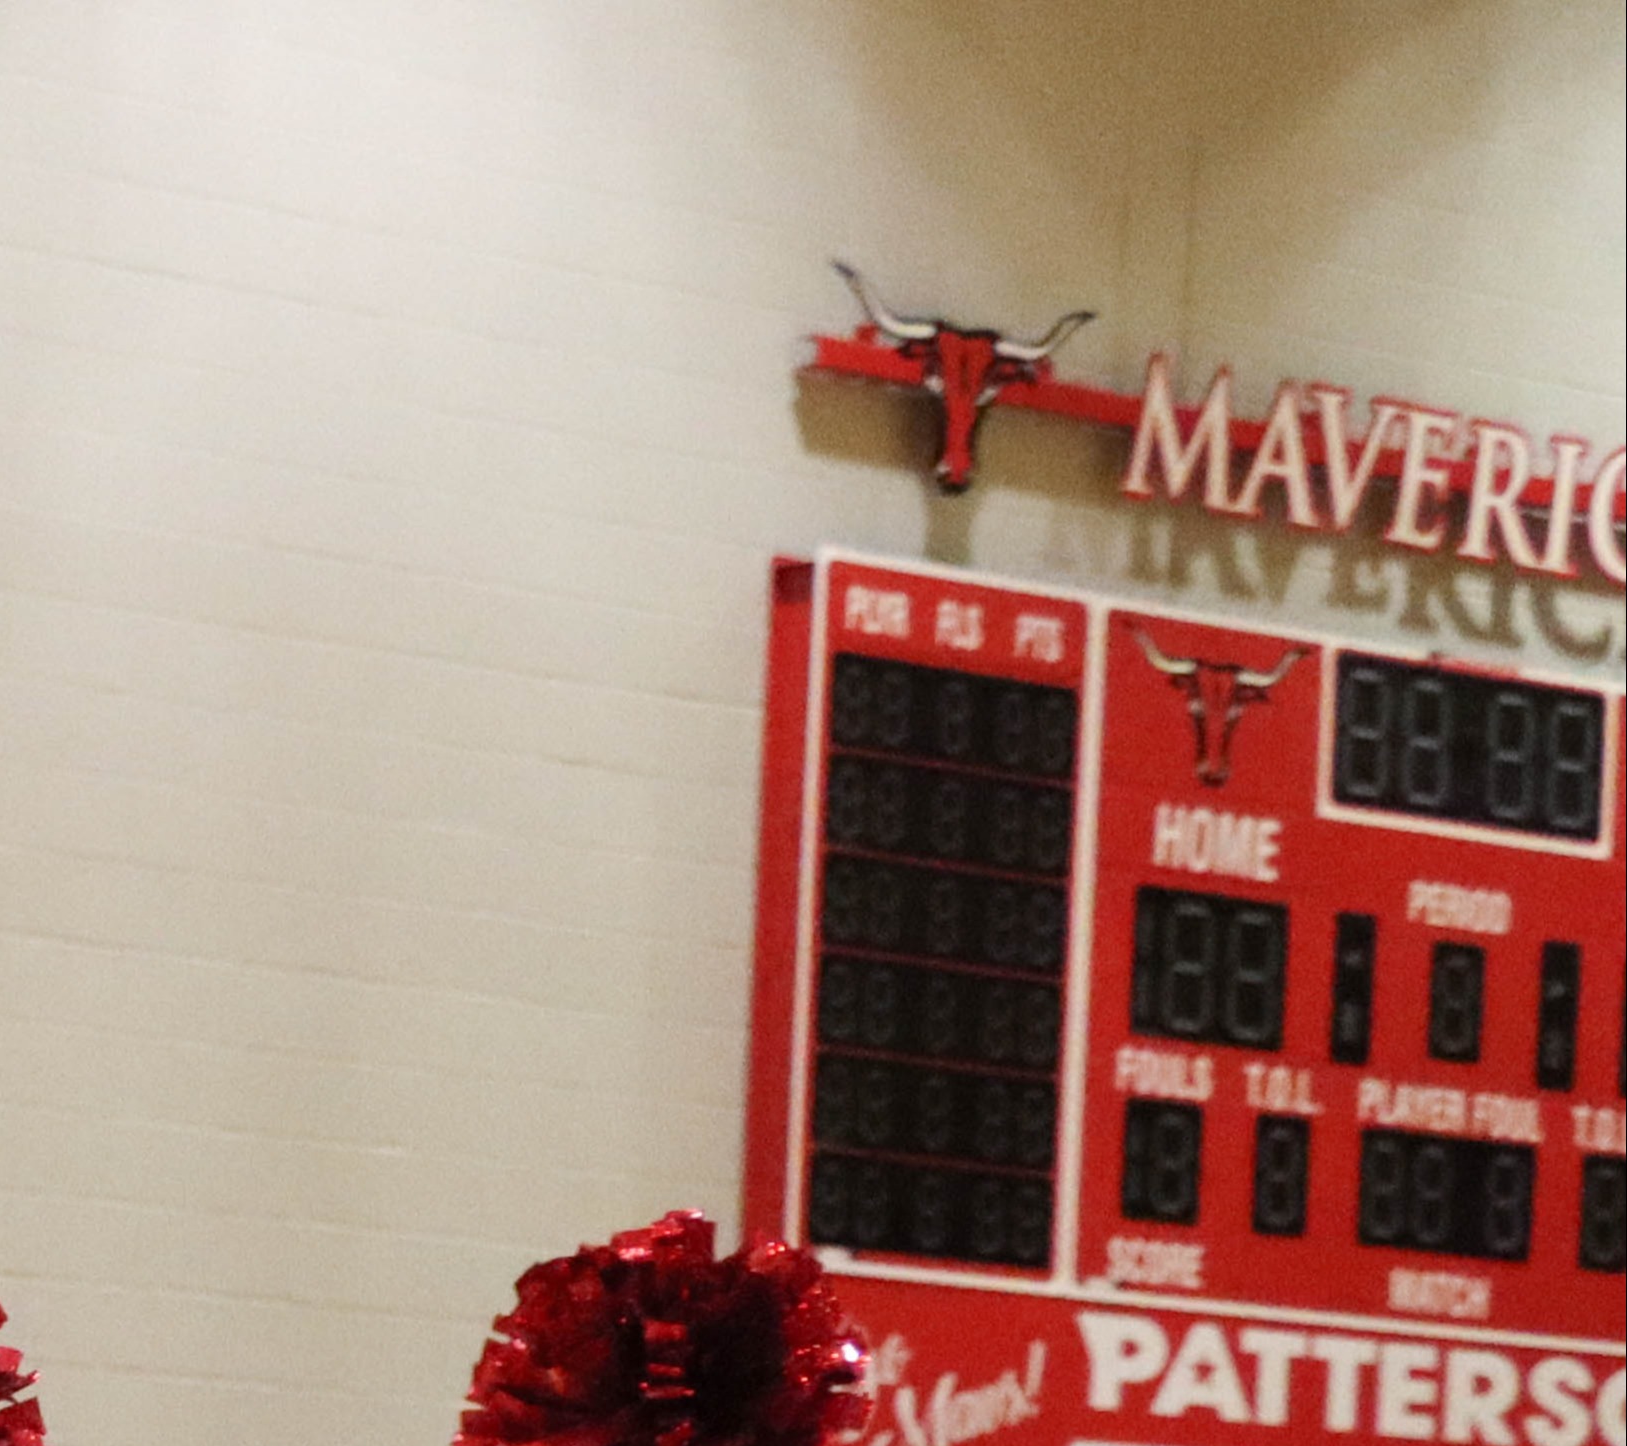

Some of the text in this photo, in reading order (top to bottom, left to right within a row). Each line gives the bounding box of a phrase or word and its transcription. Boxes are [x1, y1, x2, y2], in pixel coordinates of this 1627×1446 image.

[1152, 803, 1282, 883] HOME
[1408, 878, 1512, 935] PERIOD
[1115, 1047, 1213, 1102] FOULS
[1358, 1077, 1466, 1135] PLAYER
